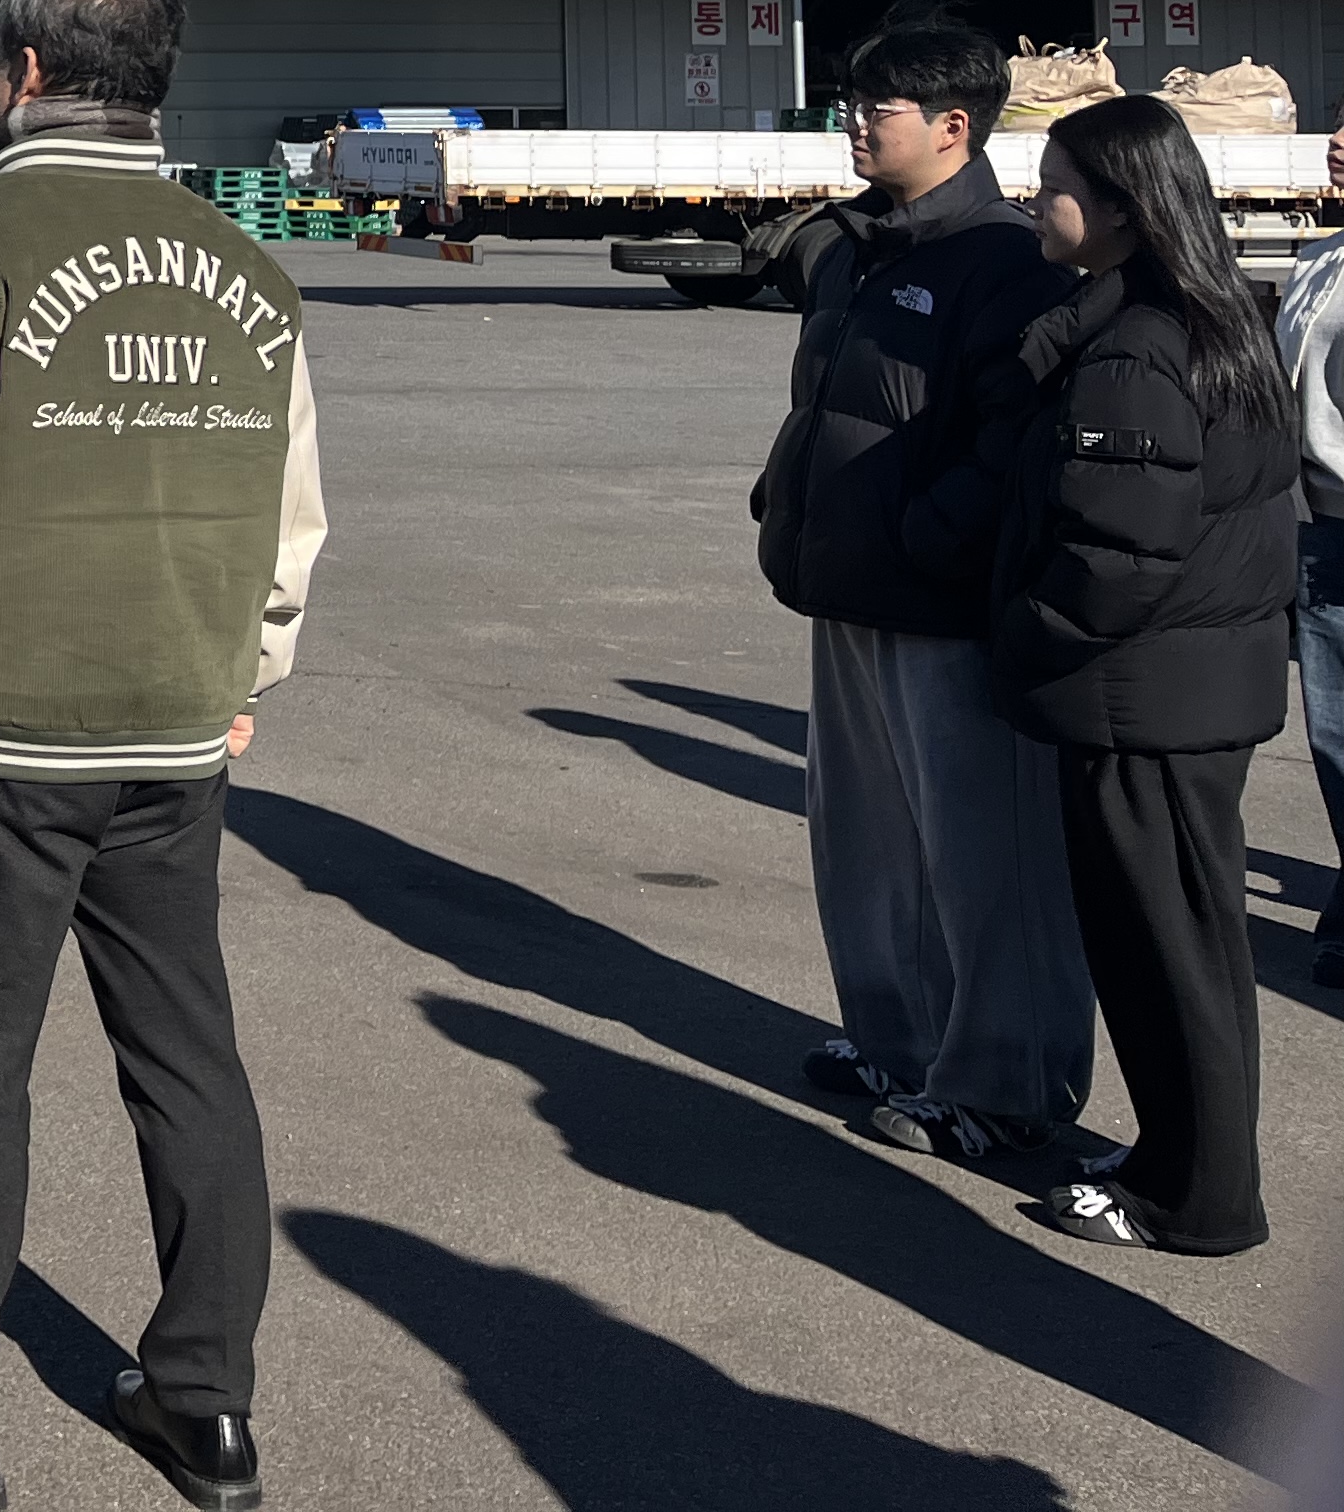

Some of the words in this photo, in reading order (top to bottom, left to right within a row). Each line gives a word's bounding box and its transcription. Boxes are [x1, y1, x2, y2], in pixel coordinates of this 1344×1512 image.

[1111, 2, 1196, 38] 구역
[361, 146, 418, 165] HYUNDAI
[105, 334, 219, 385] UNIV.
[32, 402, 103, 429] School
[107, 402, 124, 435] of
[130, 402, 198, 429] Liberal
[204, 404, 274, 430] Studies
